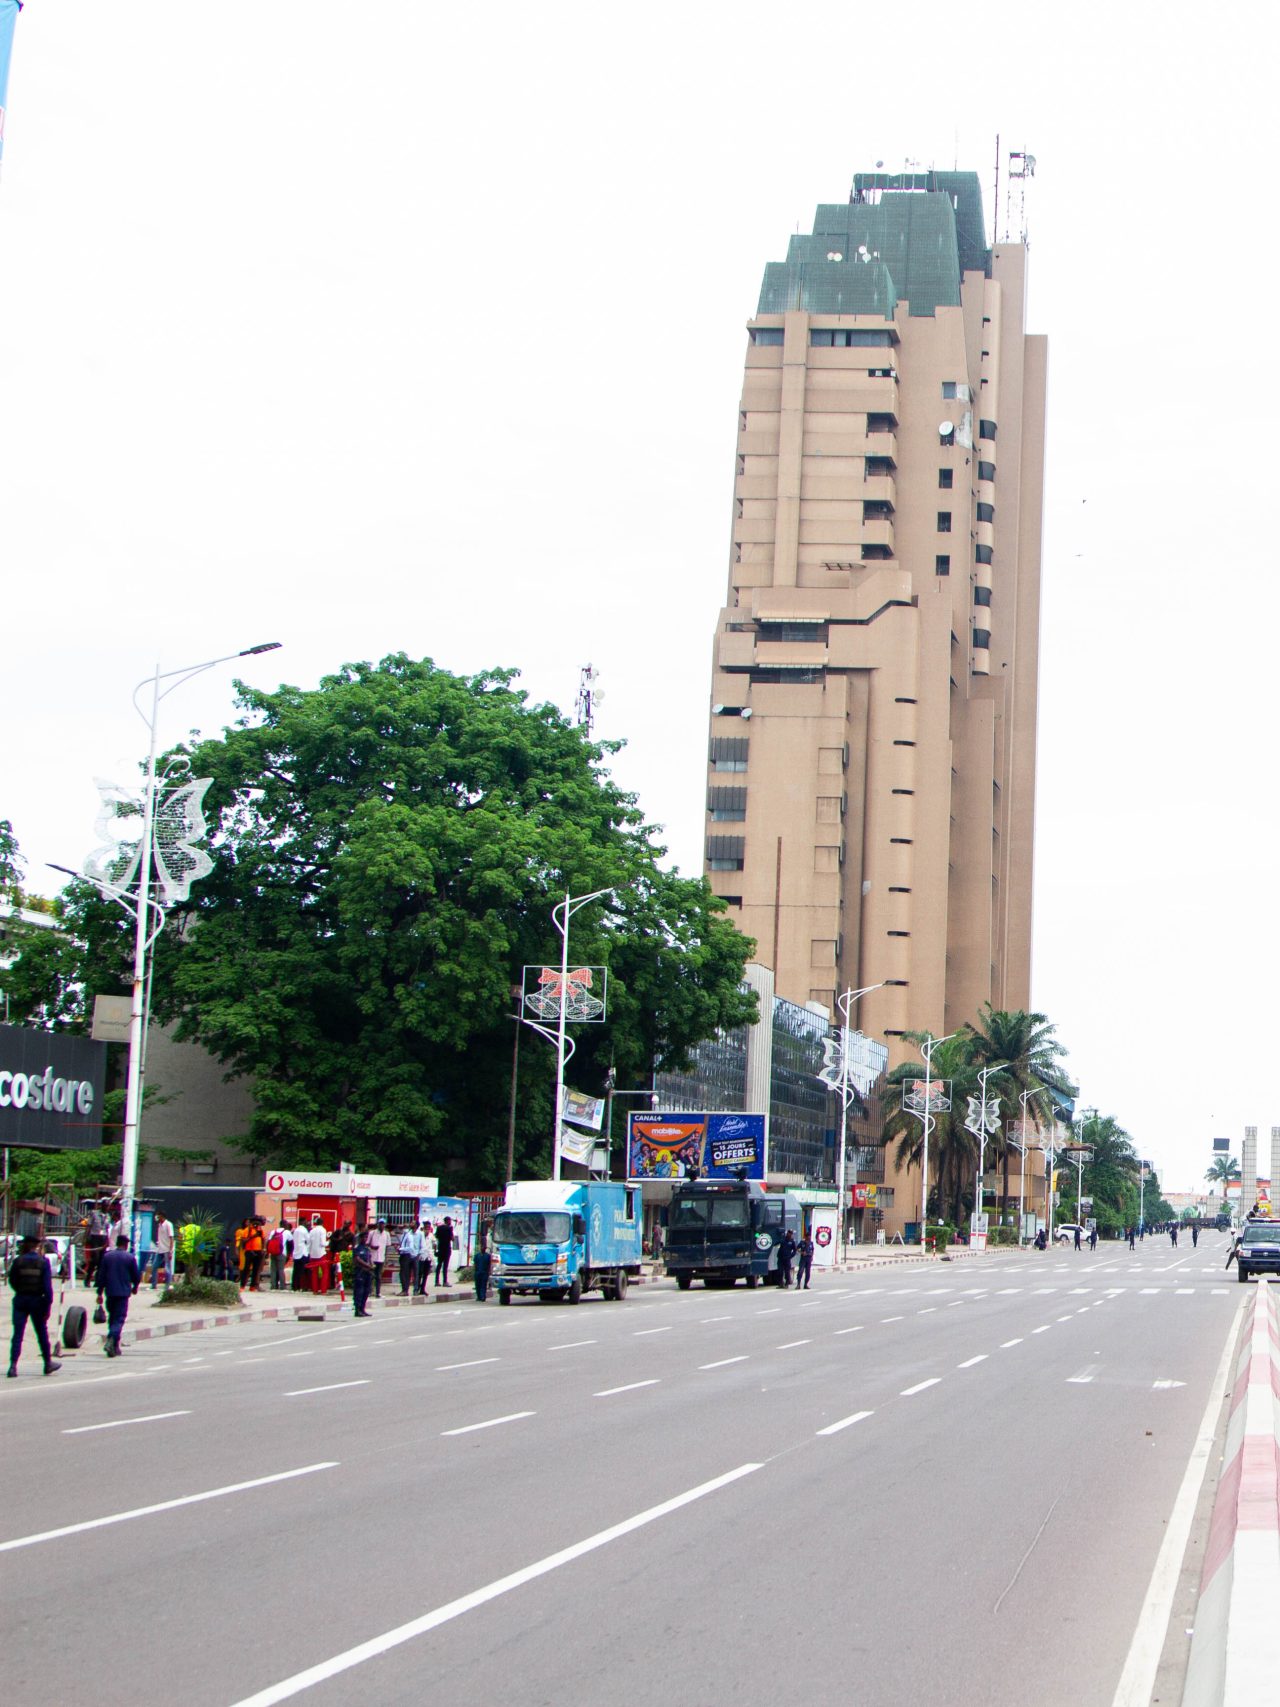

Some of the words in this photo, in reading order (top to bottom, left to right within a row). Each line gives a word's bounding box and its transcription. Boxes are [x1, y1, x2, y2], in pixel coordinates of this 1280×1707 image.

[0, 1066, 94, 1115] costore
[713, 1148, 754, 1160] OFFERTS
[288, 1179, 333, 1189] vodacom
